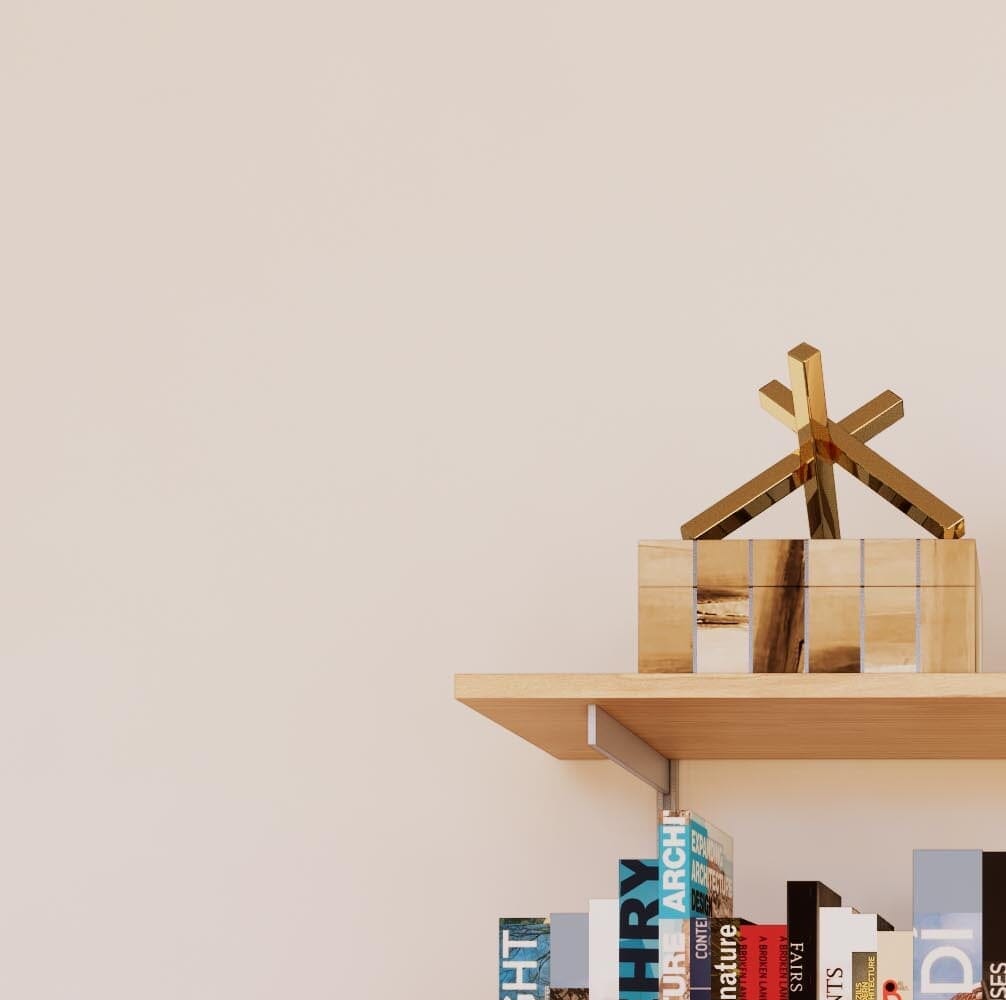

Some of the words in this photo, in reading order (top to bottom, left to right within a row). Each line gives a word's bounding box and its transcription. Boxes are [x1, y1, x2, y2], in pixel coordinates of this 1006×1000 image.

[758, 944, 767, 979] BROKEN
[779, 944, 788, 979] BROKEN
[790, 942, 804, 993] FAIRS
